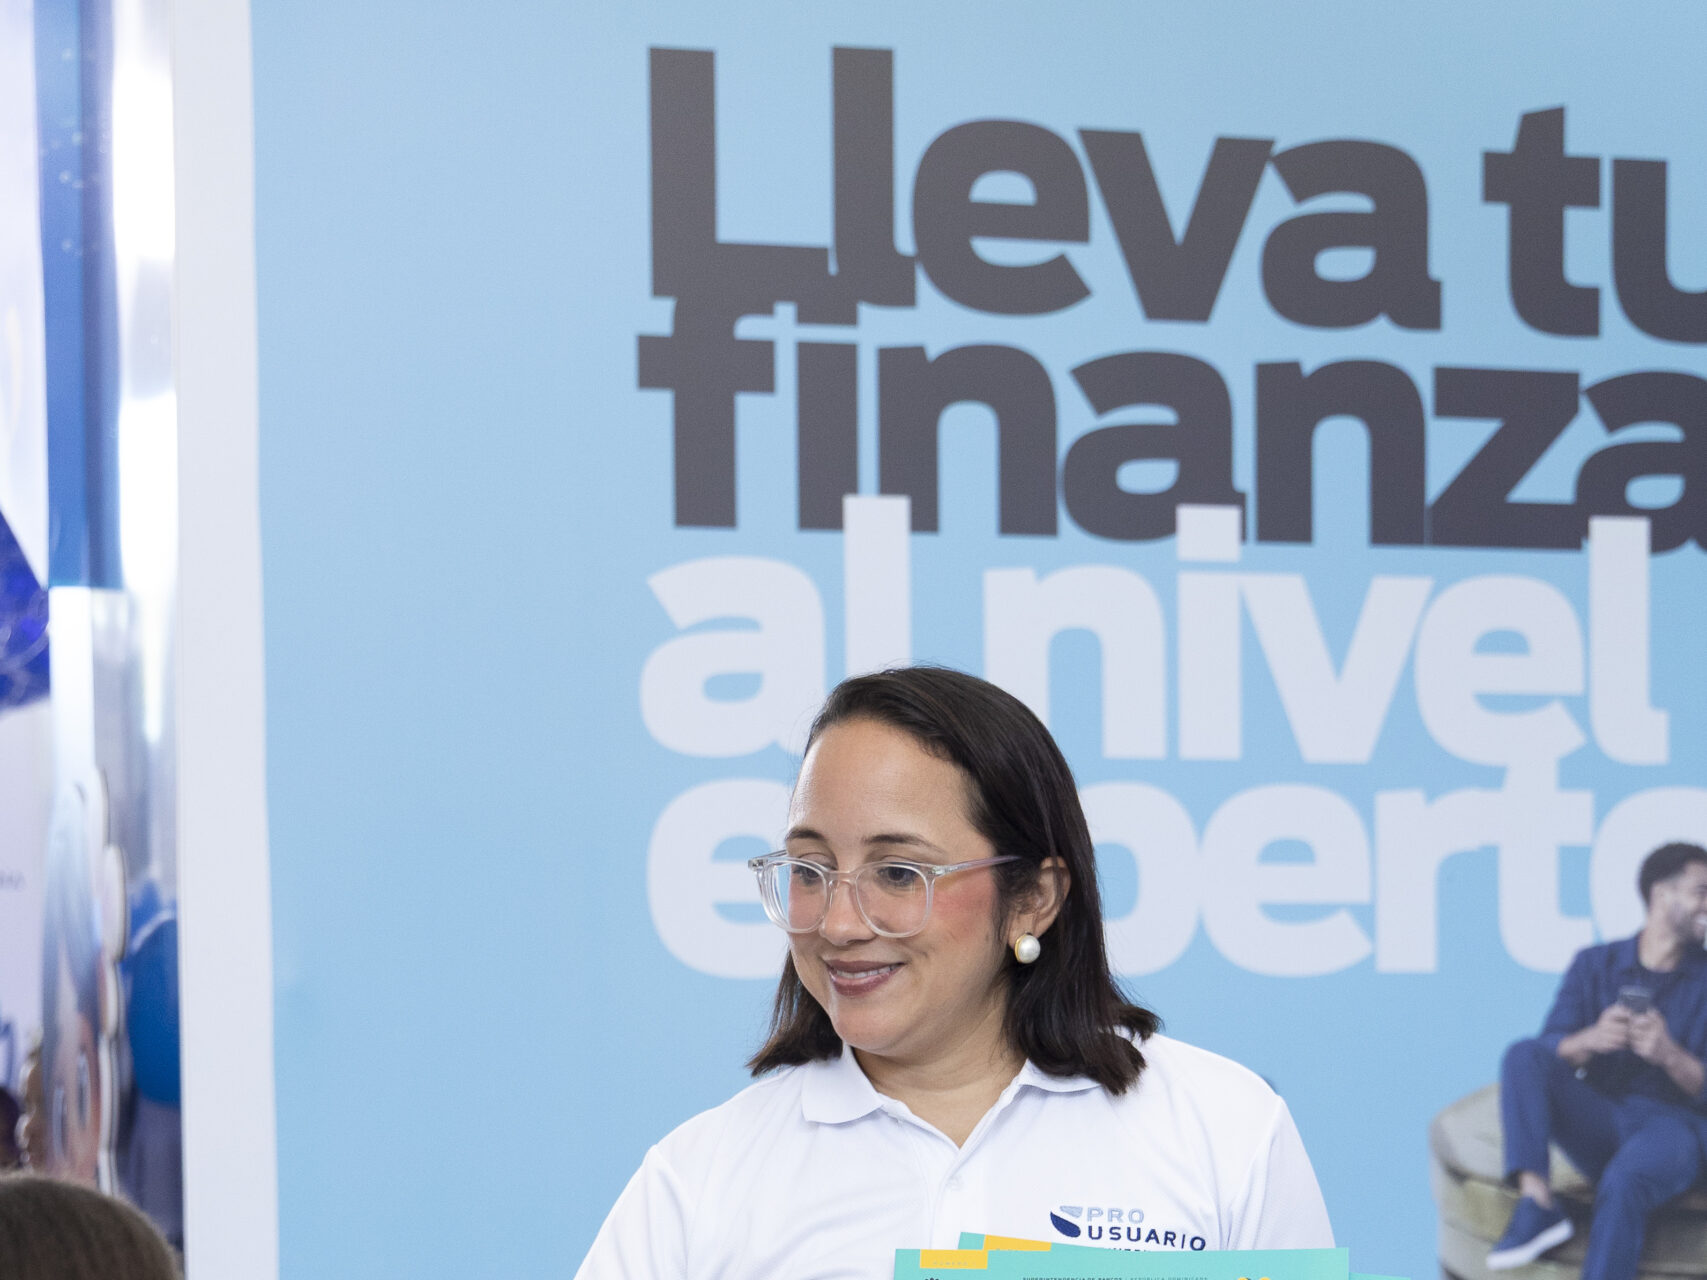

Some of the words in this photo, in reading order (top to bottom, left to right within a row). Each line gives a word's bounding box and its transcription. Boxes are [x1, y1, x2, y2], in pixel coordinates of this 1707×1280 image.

[649, 45, 1441, 331] Lleva
[637, 294, 1707, 556] finanza
[639, 494, 911, 758] al
[983, 504, 1671, 768] nivel
[647, 753, 1707, 980] eert
[1087, 1206, 1145, 1224] PRO
[1088, 1225, 1206, 1251] USUARIO
